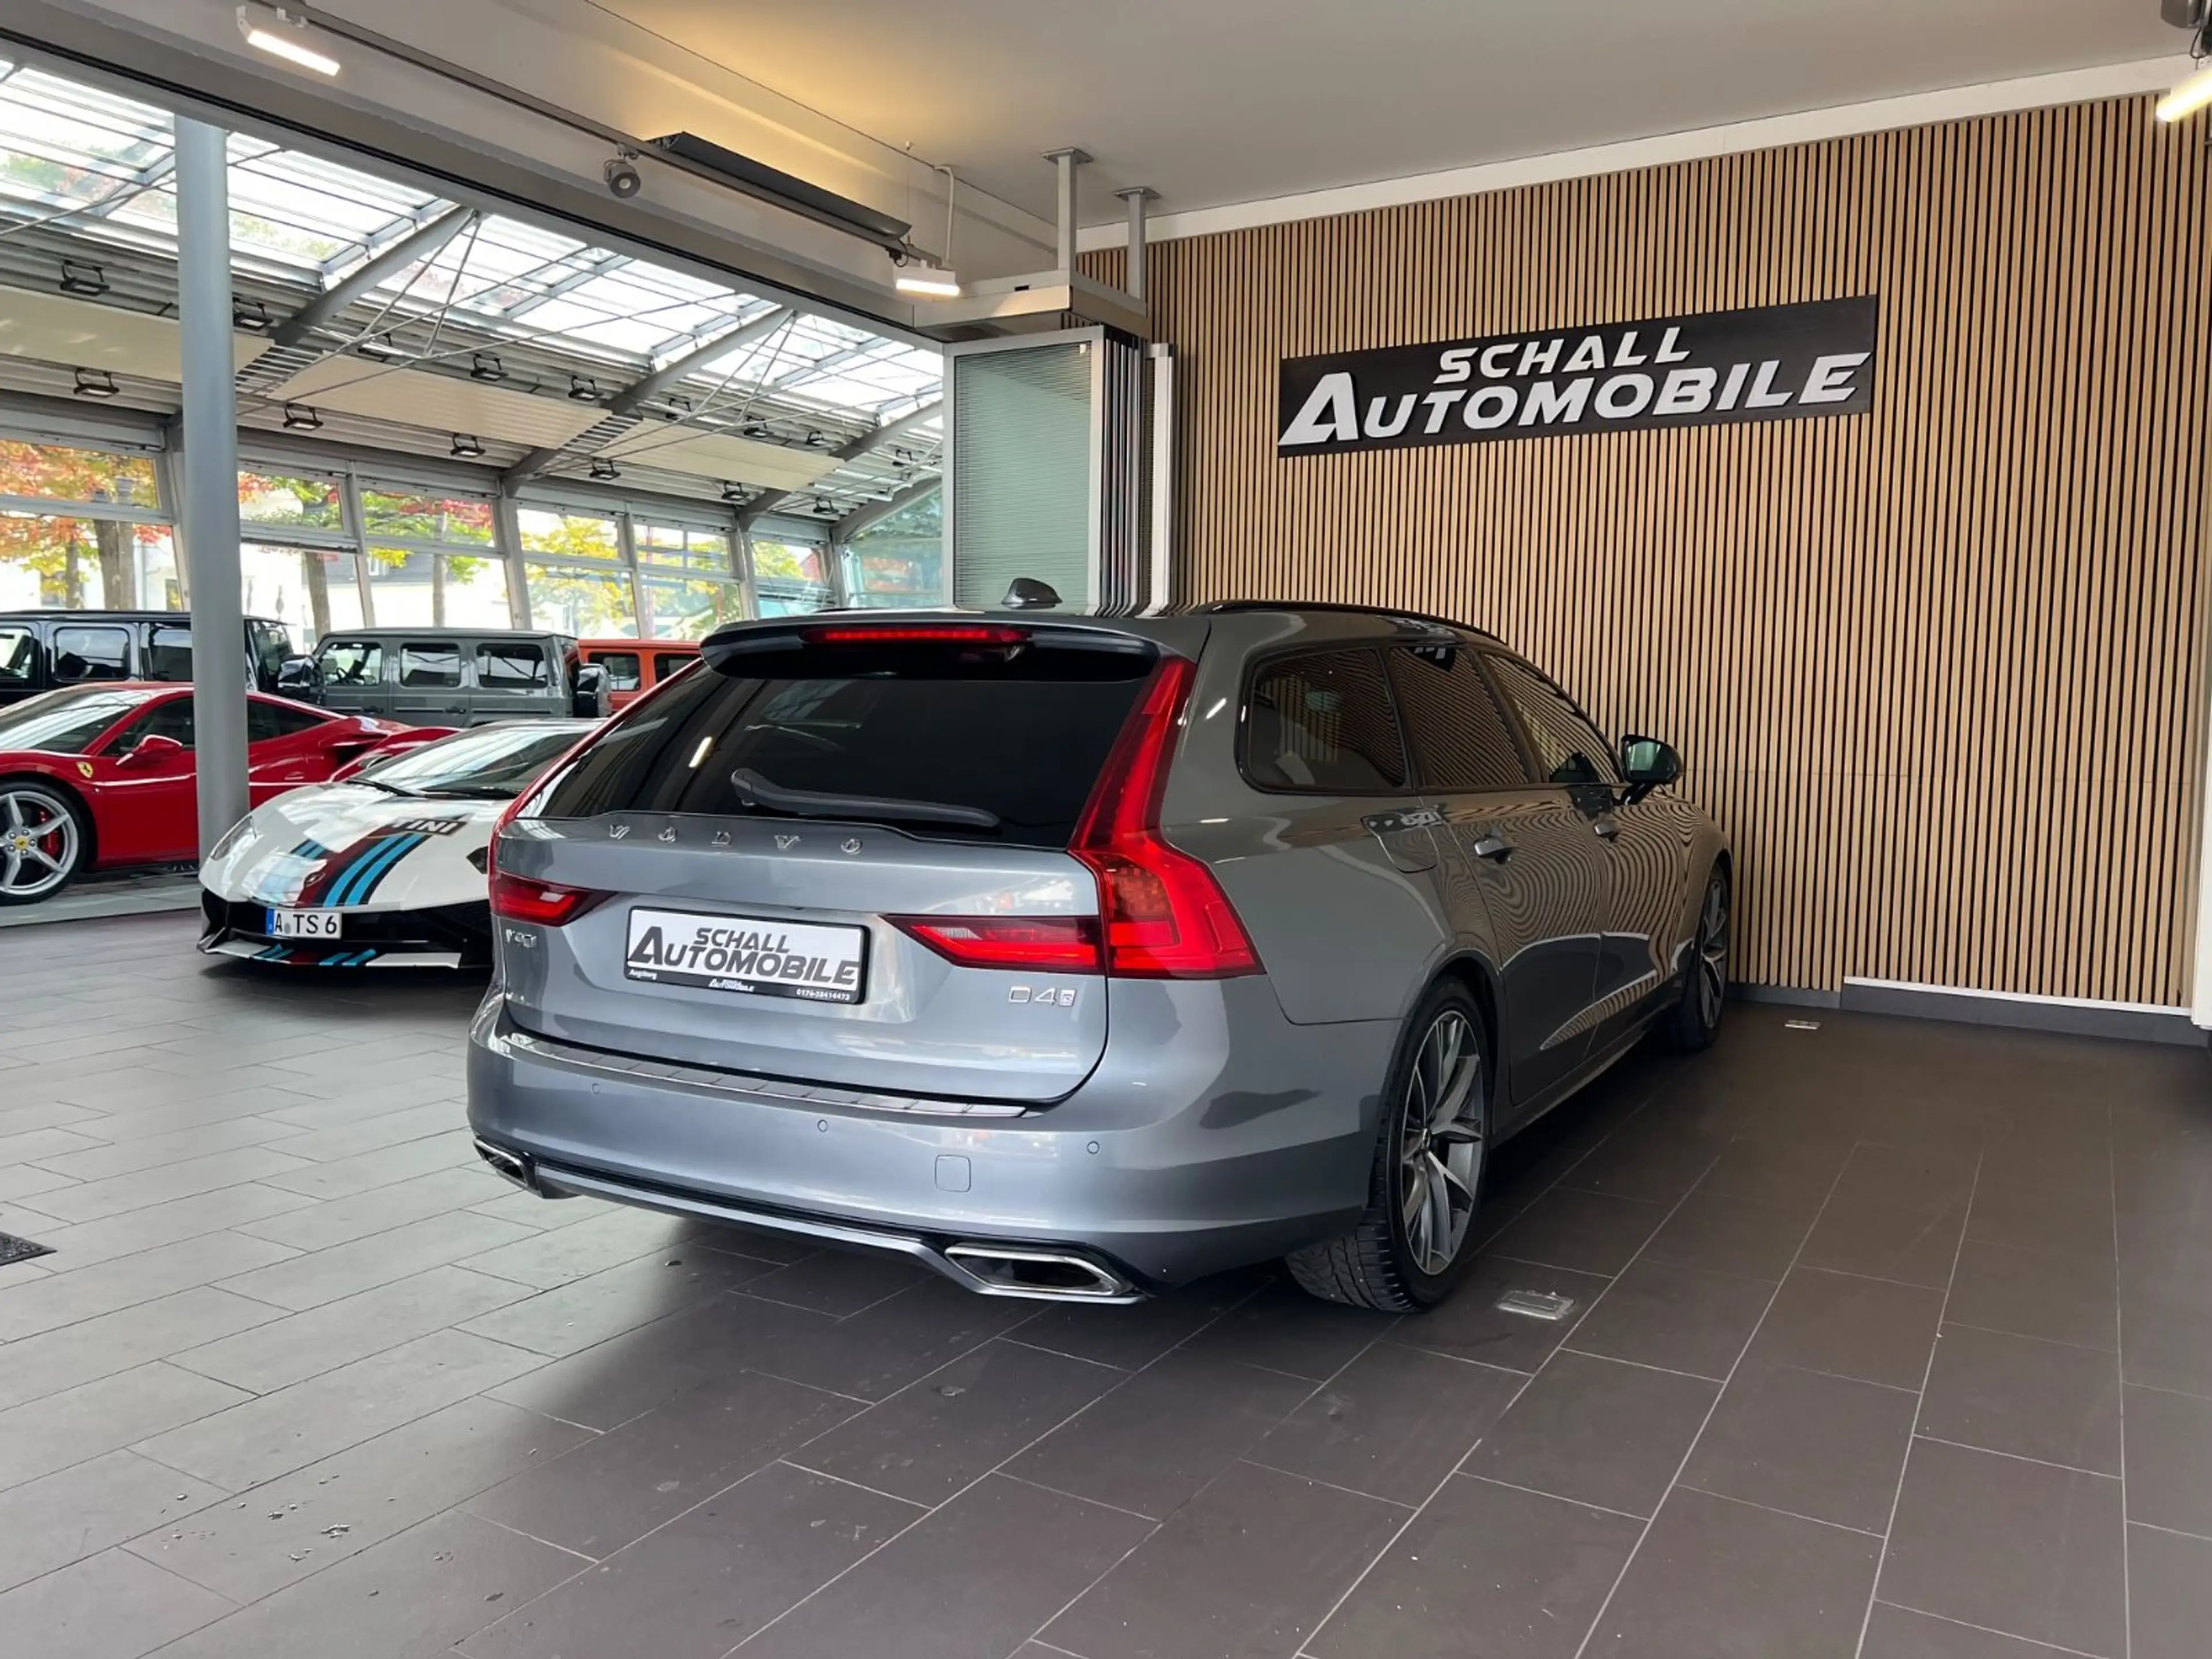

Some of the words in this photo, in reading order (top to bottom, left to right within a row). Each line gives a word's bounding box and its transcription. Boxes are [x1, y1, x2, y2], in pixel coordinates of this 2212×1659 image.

[1433, 326, 1691, 384] SCHALL
[1277, 351, 1872, 446] AUTOMOBILE
[609, 824, 863, 855] VOLVO
[275, 912, 283, 933] A
[293, 914, 319, 934] TS
[325, 915, 337, 934] 6
[693, 927, 790, 953] SCHALL
[628, 926, 860, 985] AUTOMOBILE
